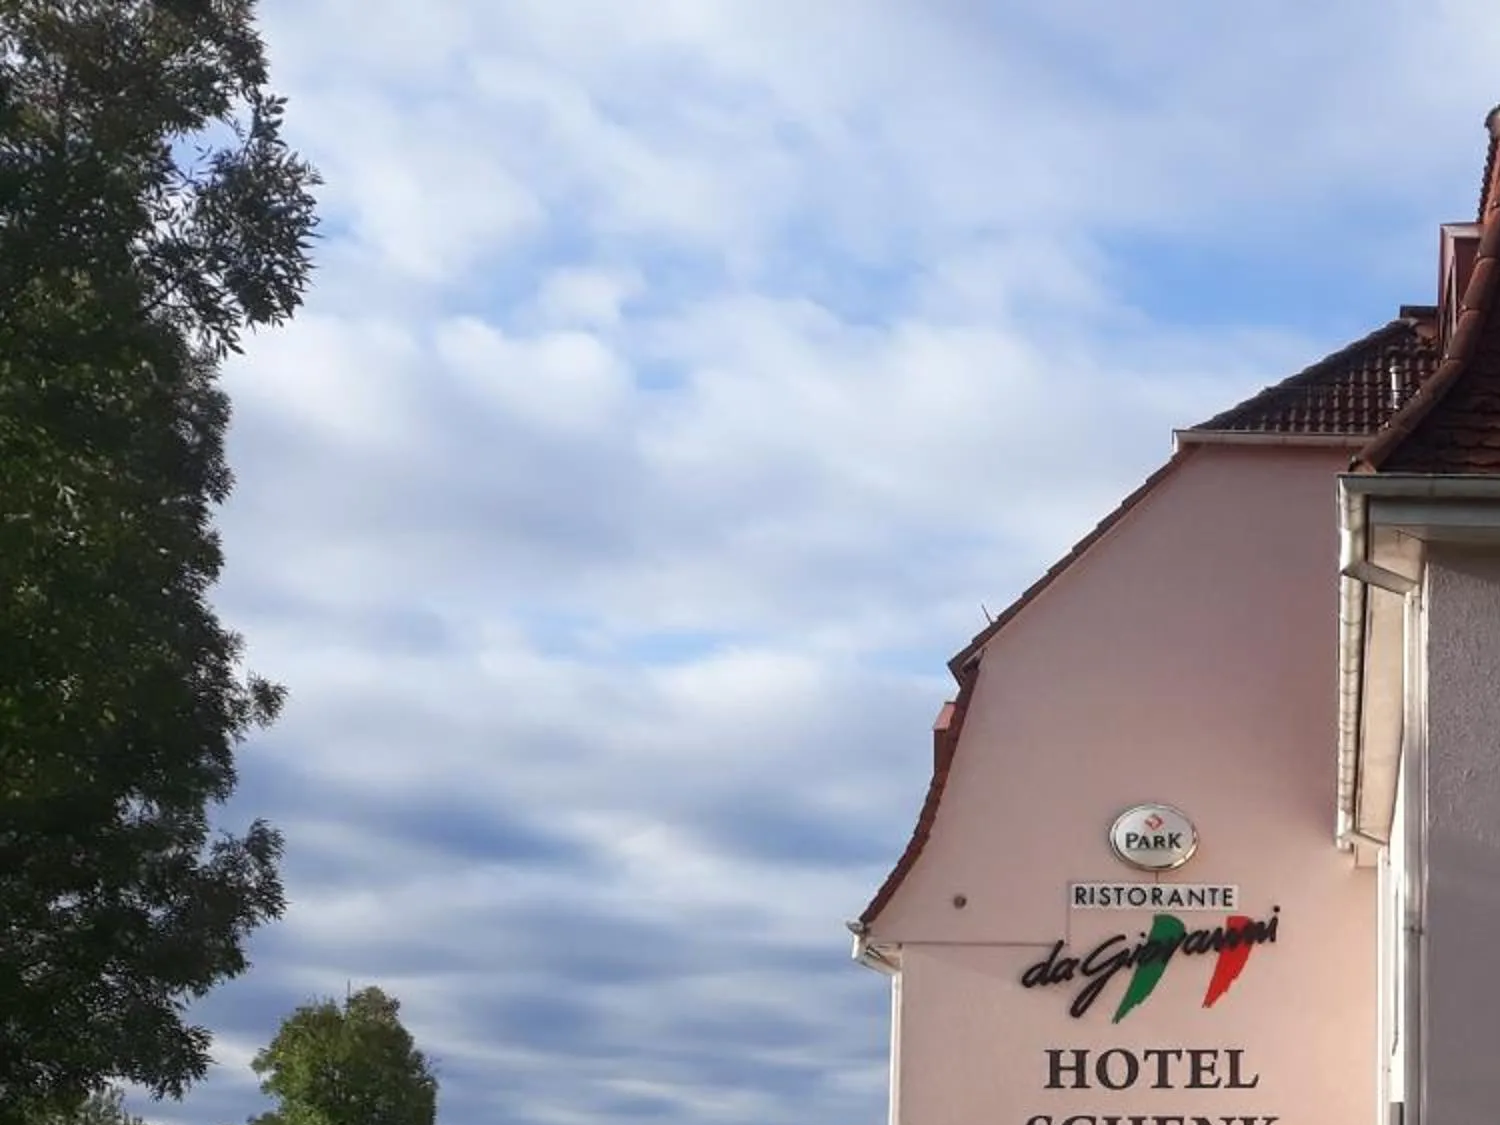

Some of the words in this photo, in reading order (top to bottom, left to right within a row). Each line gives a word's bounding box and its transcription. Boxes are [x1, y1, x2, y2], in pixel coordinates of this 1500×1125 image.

[1125, 832, 1183, 850] PARK
[1074, 886, 1234, 907] RISTORANTE
[1069, 905, 1281, 1018] Giovanni
[1043, 1048, 1260, 1091] HOTEL
